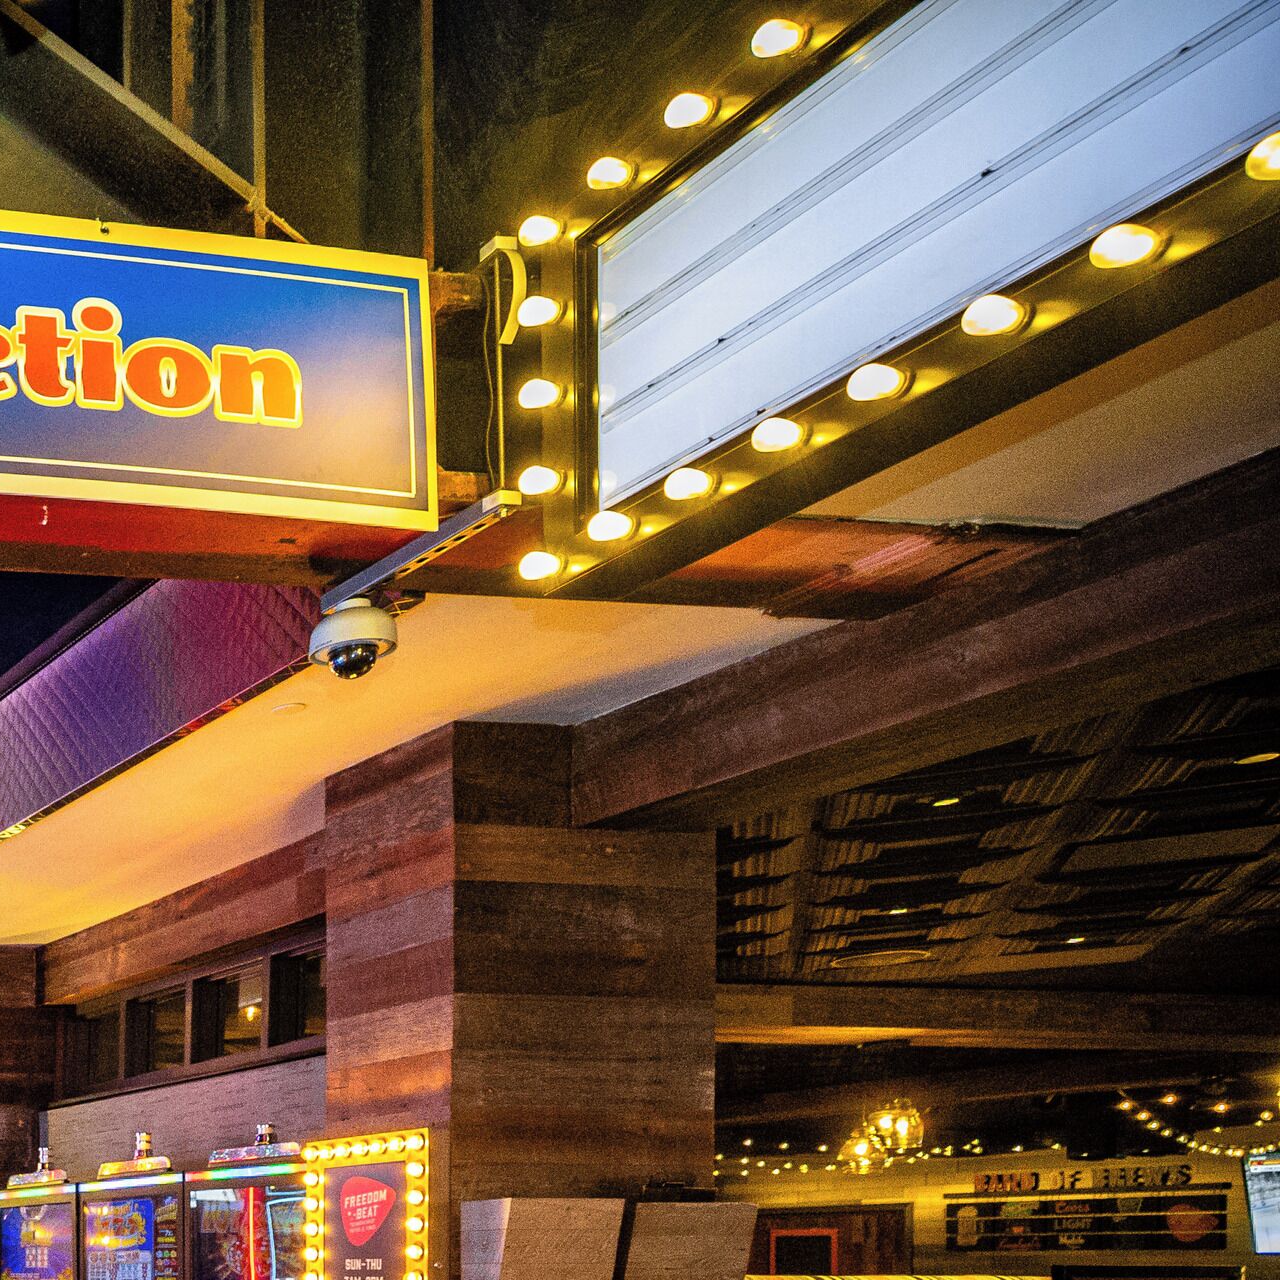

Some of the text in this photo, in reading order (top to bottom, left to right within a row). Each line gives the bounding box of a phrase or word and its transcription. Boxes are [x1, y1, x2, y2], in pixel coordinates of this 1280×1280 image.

[344, 1189, 387, 1209] FREEDOM
[355, 1205, 381, 1220] BEAT
[345, 1258, 383, 1271] SUN-THU
